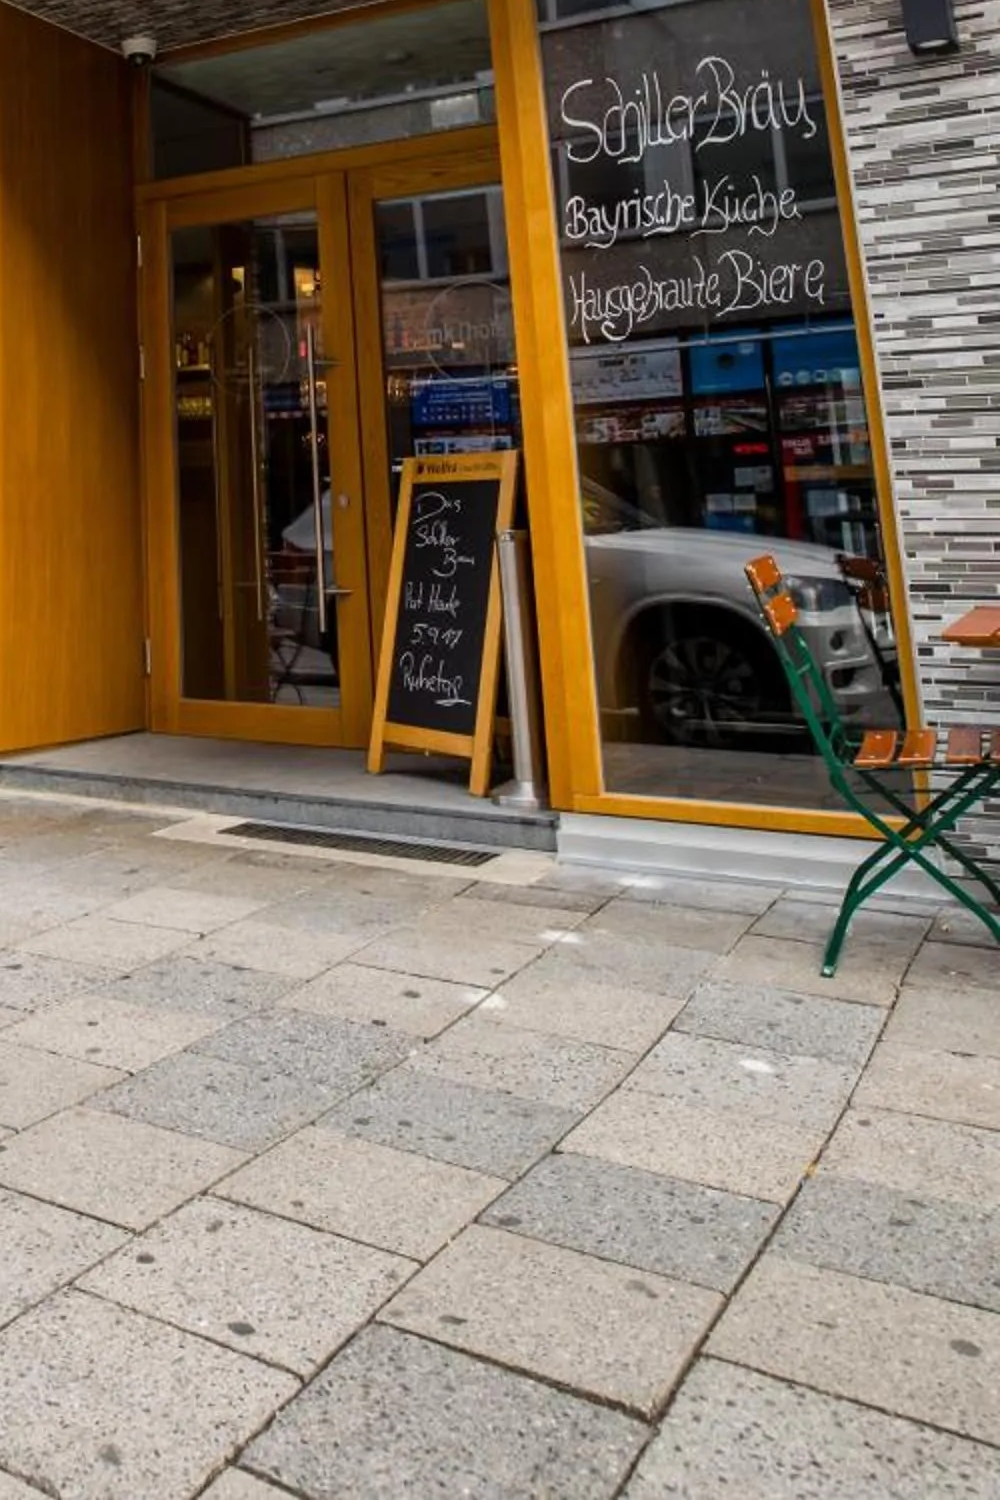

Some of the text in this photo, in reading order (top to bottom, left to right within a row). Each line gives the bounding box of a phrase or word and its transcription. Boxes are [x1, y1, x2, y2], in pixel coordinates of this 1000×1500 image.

[565, 175, 804, 249] Bayrische Küche
[716, 249, 826, 318] Biere
